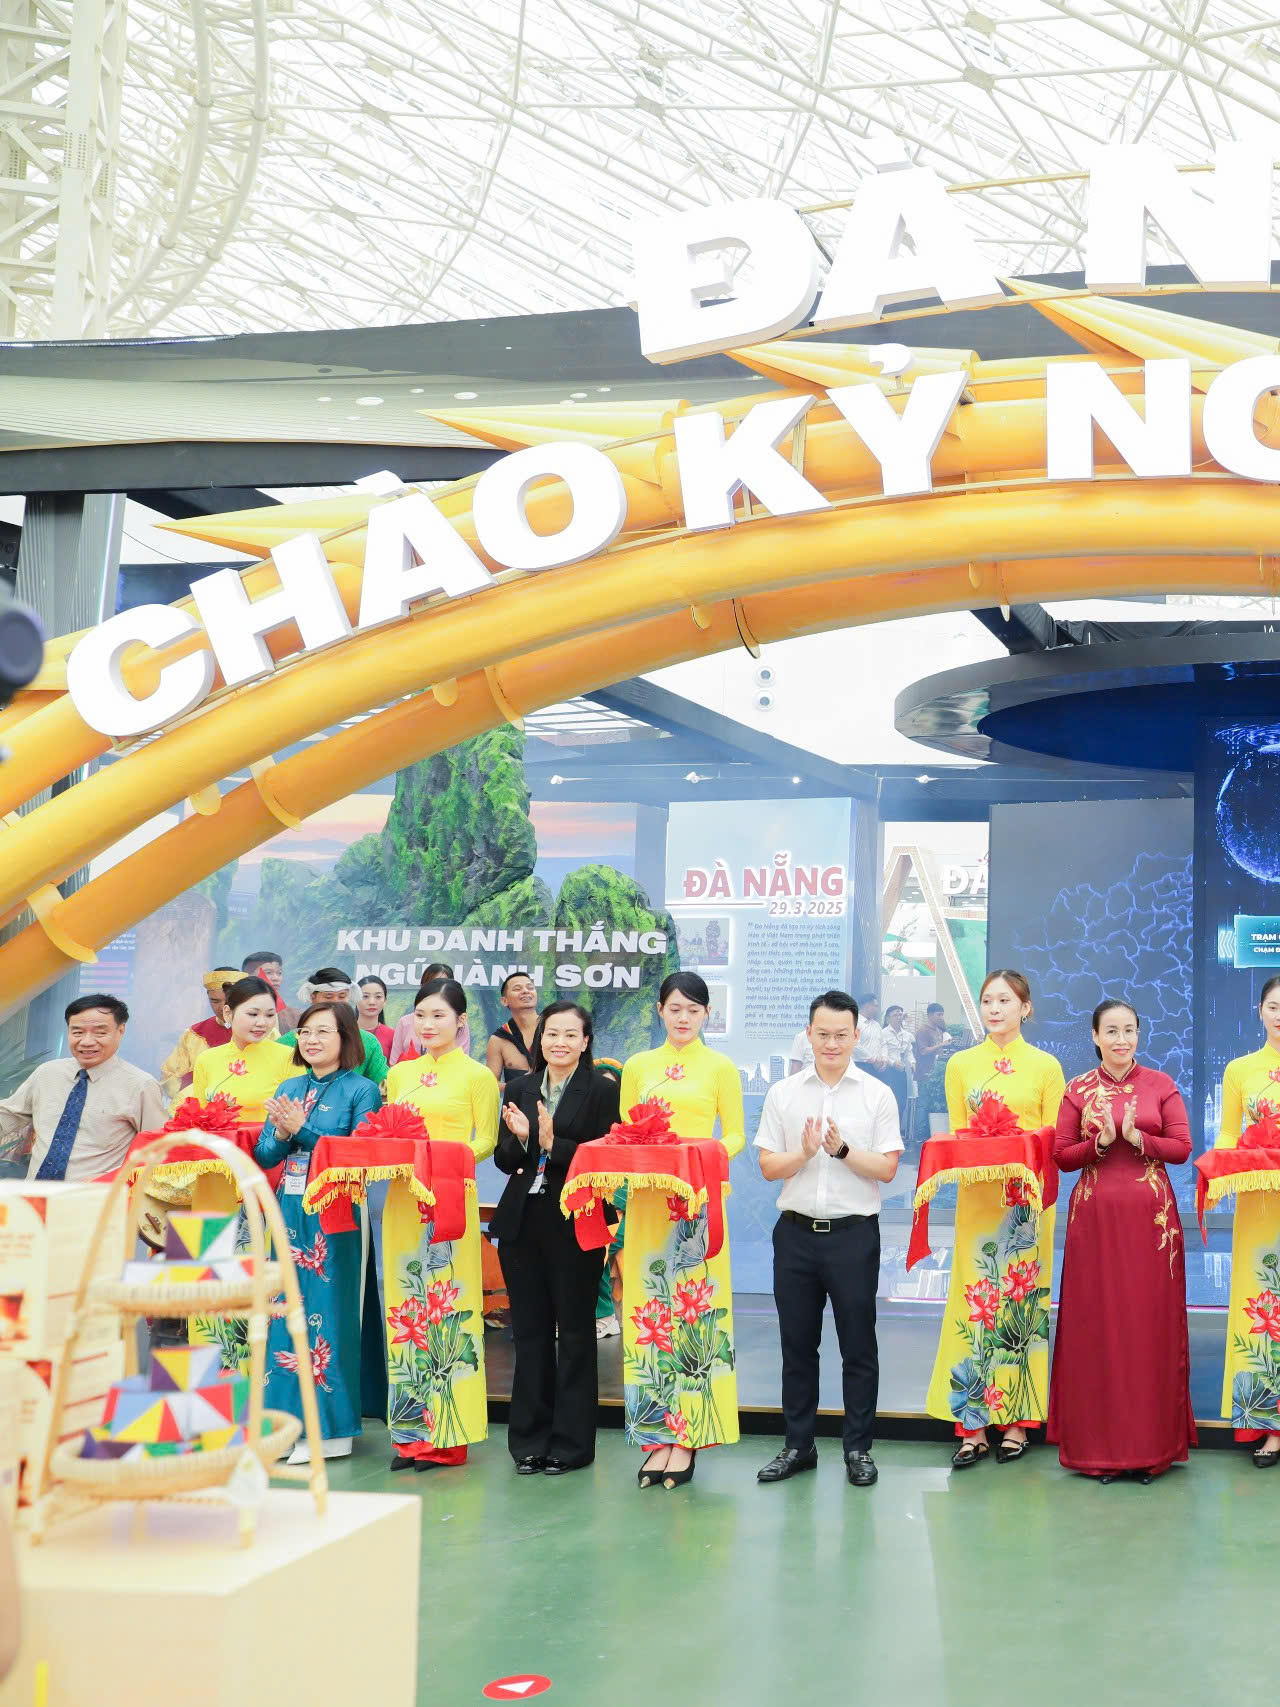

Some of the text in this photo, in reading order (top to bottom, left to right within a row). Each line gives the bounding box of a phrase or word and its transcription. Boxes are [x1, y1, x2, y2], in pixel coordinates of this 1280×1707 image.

[627, 134, 1010, 364] ĐÀ
[66, 441, 628, 738] CHÀO
[673, 342, 969, 532] KỶ
[682, 853, 845, 898] ĐÀ NẴNG
[768, 901, 844, 915] 29.3.2025
[336, 920, 668, 955] KHU DANH THẮNG
[1250, 933, 1277, 942] TRẠM
[354, 956, 641, 989] NGŨ ÀNH SƠN
